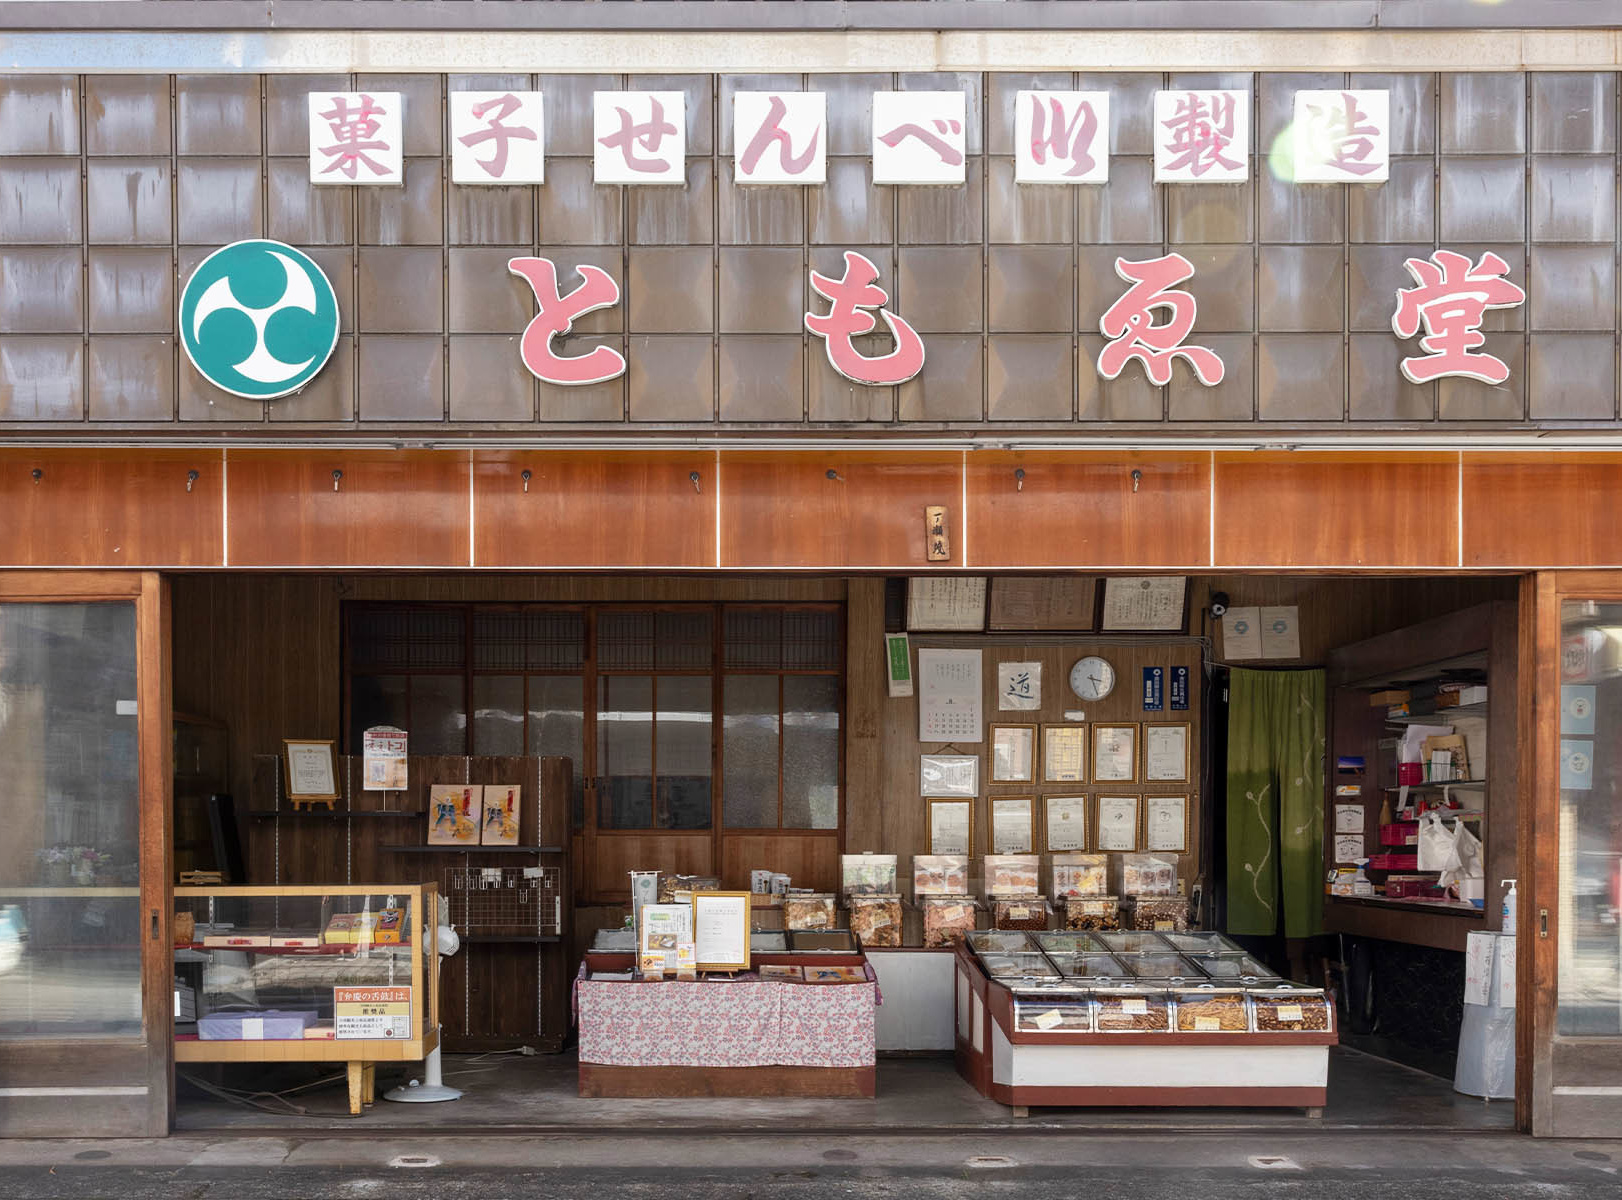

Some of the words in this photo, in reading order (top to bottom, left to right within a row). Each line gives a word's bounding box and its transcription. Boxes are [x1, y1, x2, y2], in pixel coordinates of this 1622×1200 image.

[507, 249, 1527, 388] ともゑ堂
[1007, 672, 1034, 699] 道
